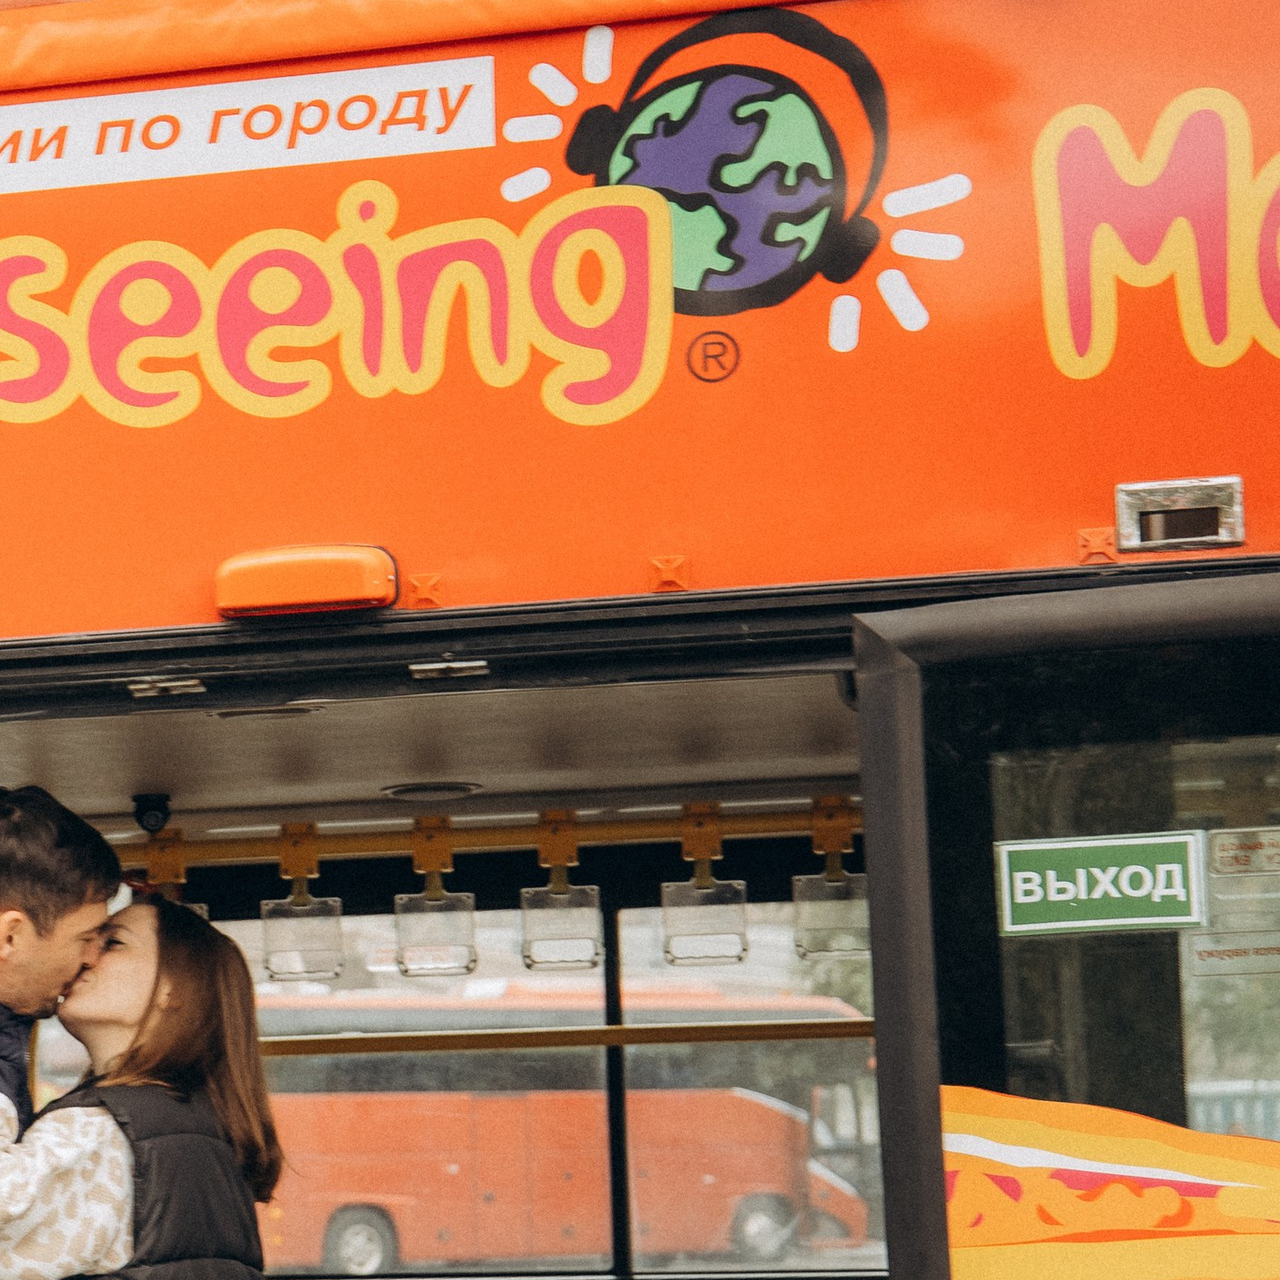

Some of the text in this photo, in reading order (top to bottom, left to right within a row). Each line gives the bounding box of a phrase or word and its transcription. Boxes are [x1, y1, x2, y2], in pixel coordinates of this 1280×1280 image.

[94, 112, 182, 155] по
[207, 83, 474, 149] городу
[1013, 863, 1187, 904] ВЫХОД
